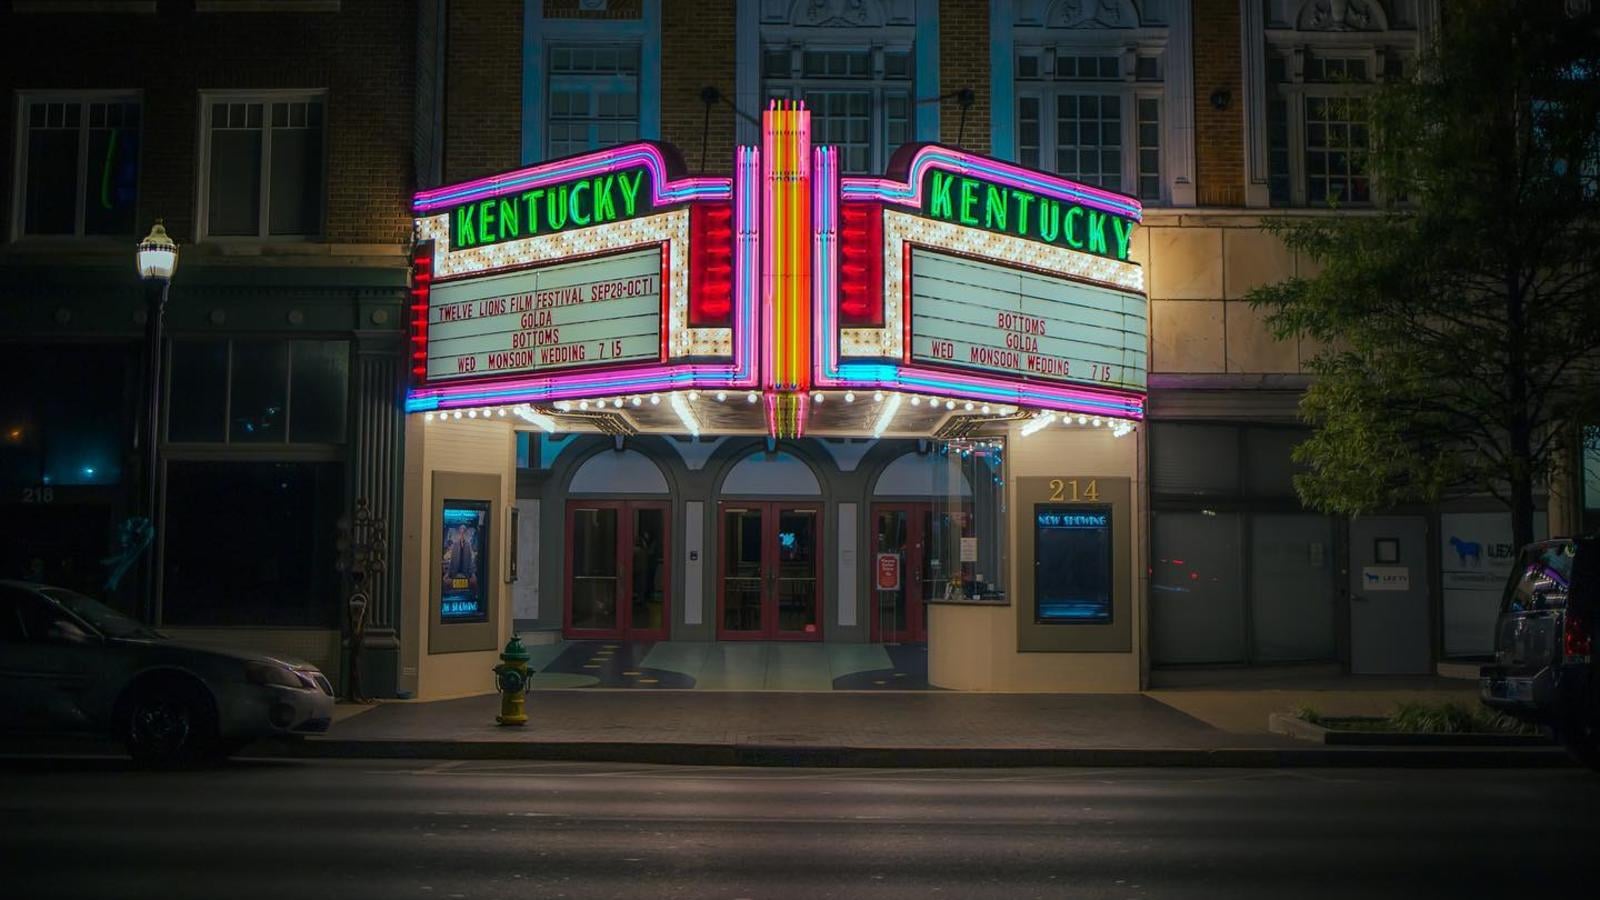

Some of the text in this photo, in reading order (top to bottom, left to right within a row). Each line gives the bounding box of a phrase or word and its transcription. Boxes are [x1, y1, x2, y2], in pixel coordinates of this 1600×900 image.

[457, 169, 644, 248] KENTUCKY
[930, 170, 1133, 260] KENTUCKY
[439, 303, 473, 321] TWELVE
[479, 299, 506, 316] LIONS
[510, 295, 532, 312] FILM
[537, 287, 584, 308] FESTIVAL
[520, 310, 552, 329] GOLDA
[997, 313, 1046, 335] BOTTOMS
[512, 328, 559, 349] BOTTOMS
[1006, 332, 1038, 353] GOLDA
[457, 340, 622, 371] WED MONSOON WEDDING 7 15
[931, 340, 954, 360] WED
[970, 346, 1019, 368] MONSOON
[1027, 354, 1069, 375] WEDDING
[1091, 364, 1098, 379] 7
[21, 487, 54, 504] 218
[1049, 479, 1099, 502] 214
[1064, 515, 1106, 525] SHOWING
